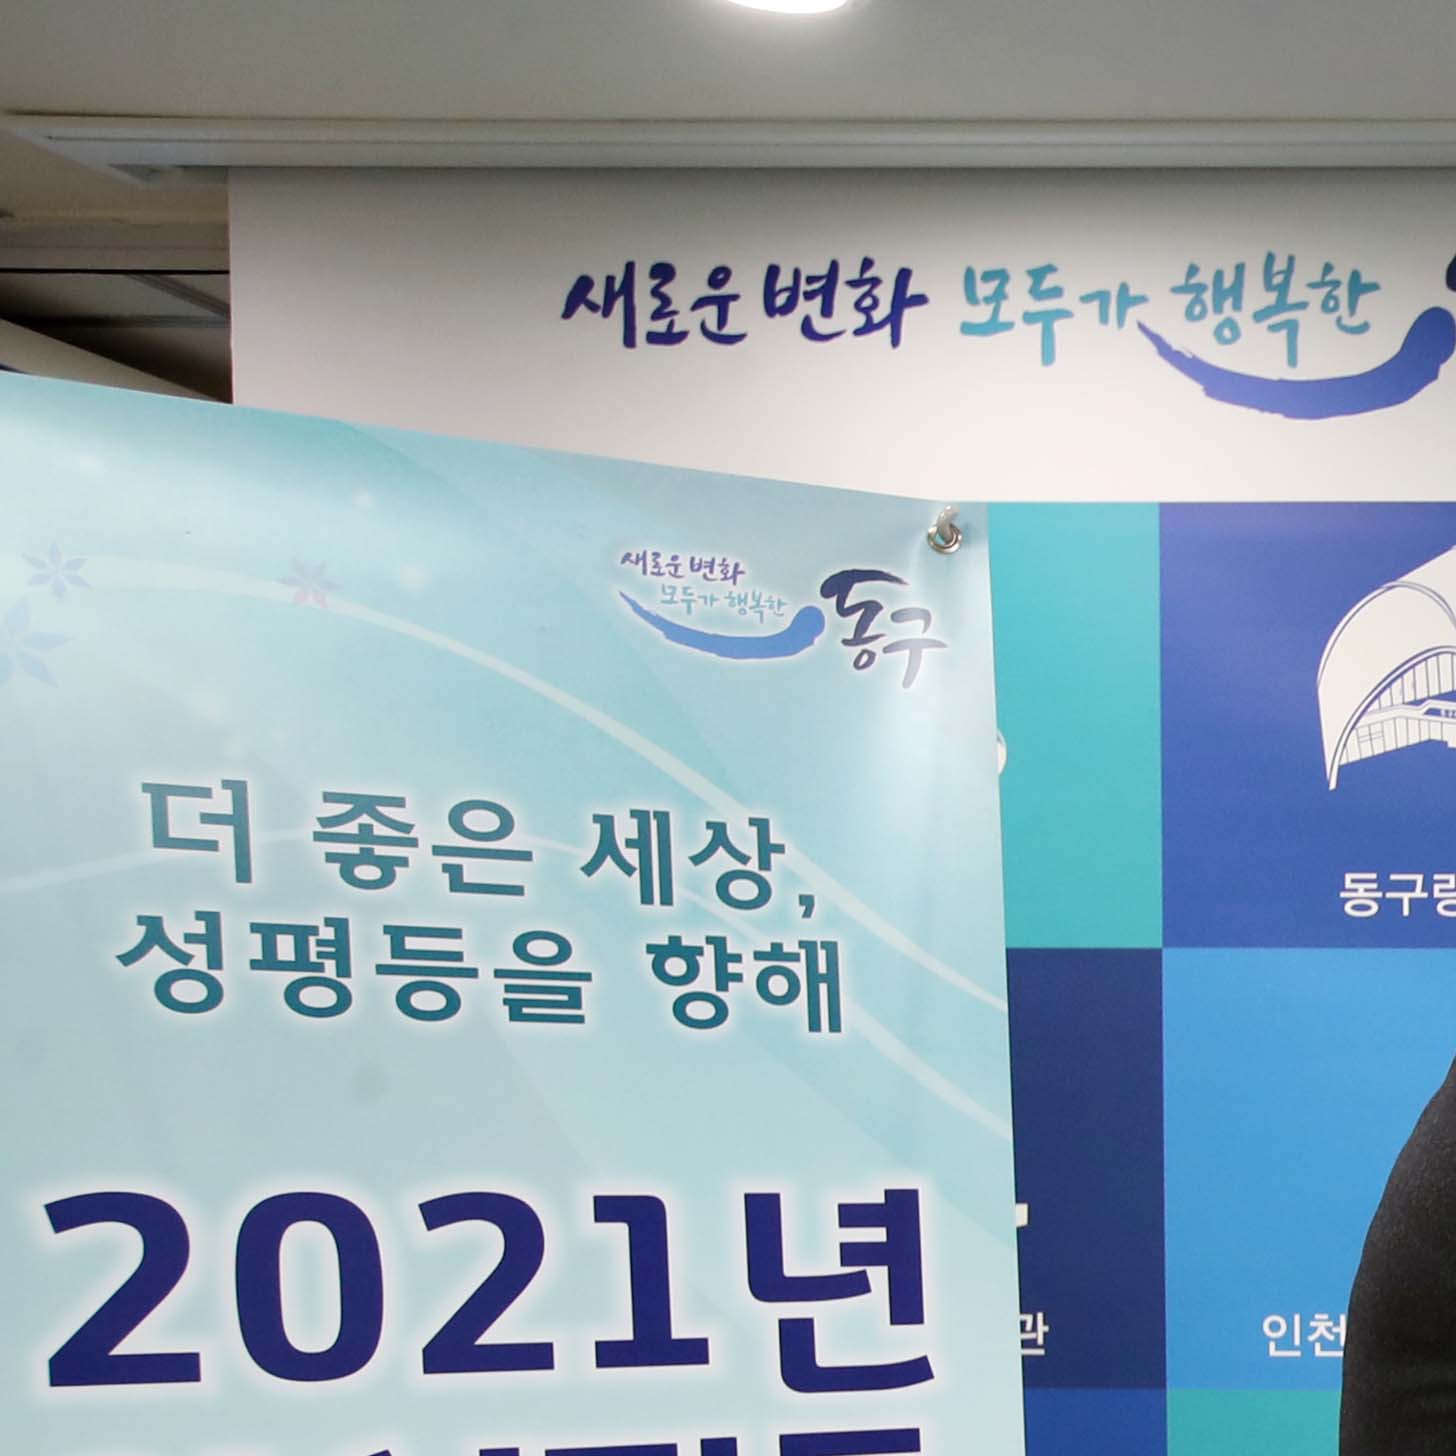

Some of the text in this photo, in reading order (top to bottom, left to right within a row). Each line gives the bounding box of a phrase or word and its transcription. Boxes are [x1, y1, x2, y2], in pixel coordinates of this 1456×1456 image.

[560, 260, 748, 350] 새로운
[761, 256, 930, 350] 변화
[958, 264, 1146, 365] 모두가
[1170, 250, 1383, 368] 행복한
[620, 550, 686, 579] 새로운
[689, 555, 747, 586] 변화
[819, 567, 949, 690] 동구
[139, 778, 819, 920] 더 좋은 세상,
[115, 909, 845, 1035] 성평등을 향해
[43, 1187, 937, 1396] 2021년
